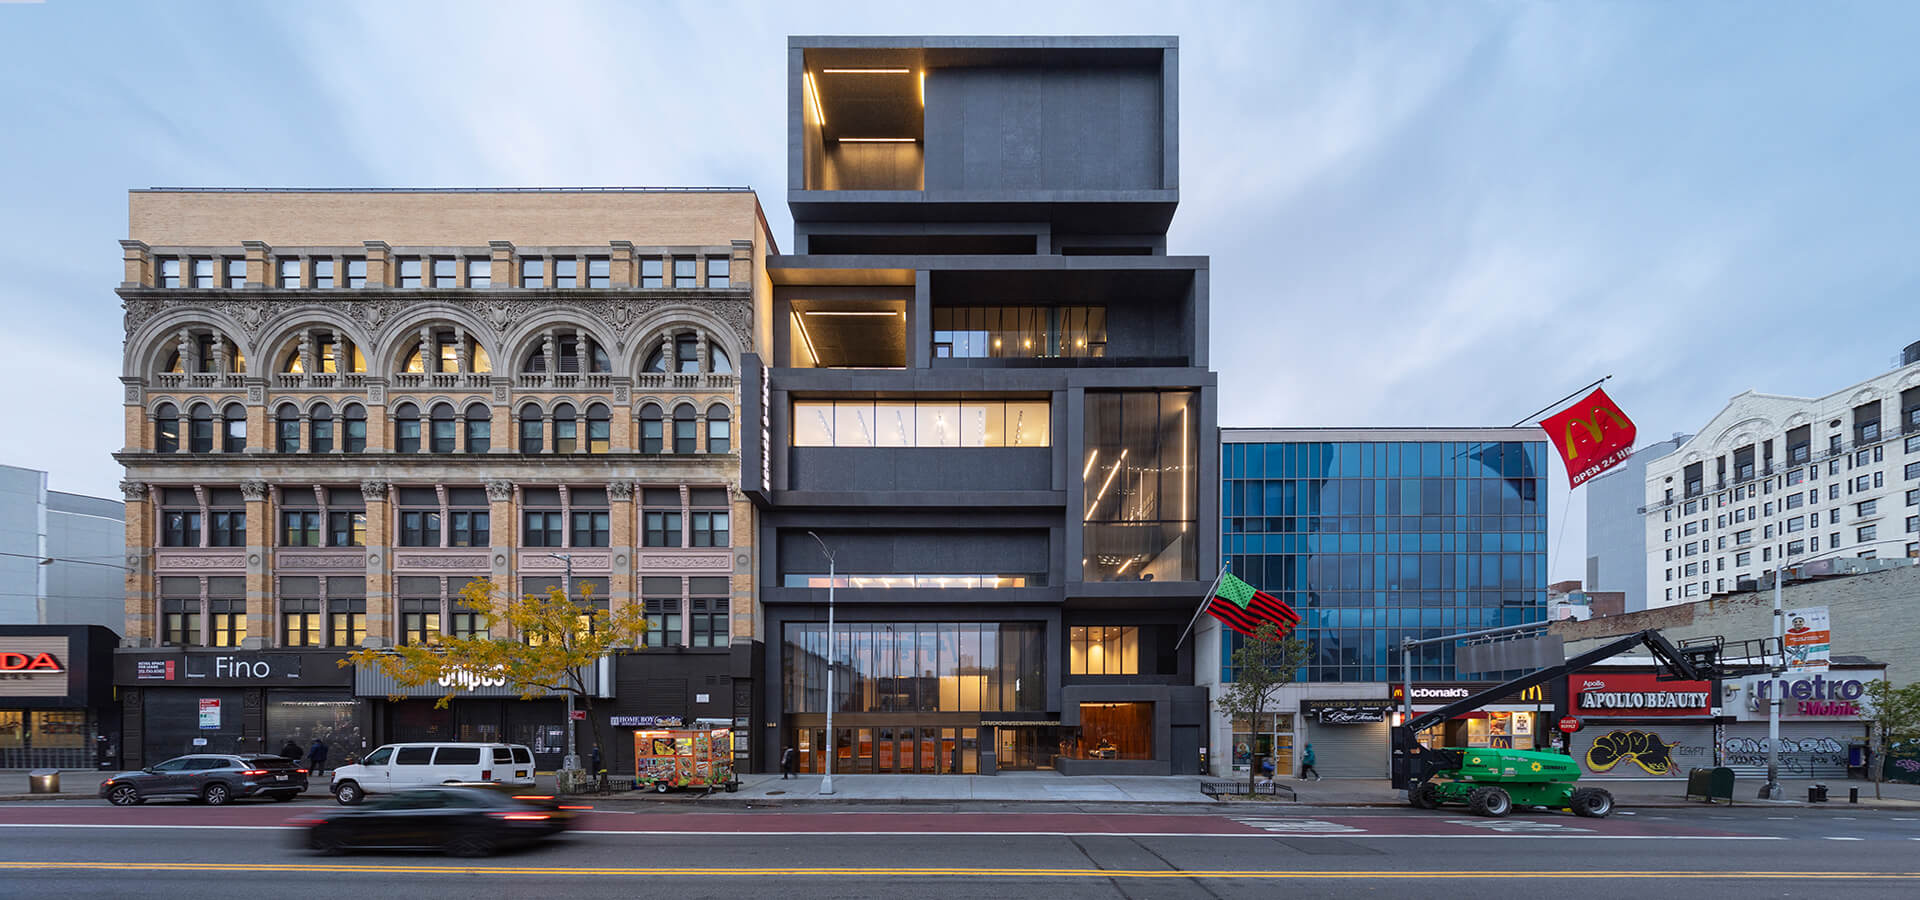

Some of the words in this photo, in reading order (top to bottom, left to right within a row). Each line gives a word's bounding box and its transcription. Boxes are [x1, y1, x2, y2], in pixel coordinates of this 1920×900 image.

[1572, 464, 1601, 484] OPEN
[1601, 455, 1616, 468] 24
[215, 656, 270, 678] Fino
[1410, 688, 1469, 698] cDonald's
[1582, 692, 1644, 708] APOLLO
[1647, 692, 1709, 708] BEAUTY
